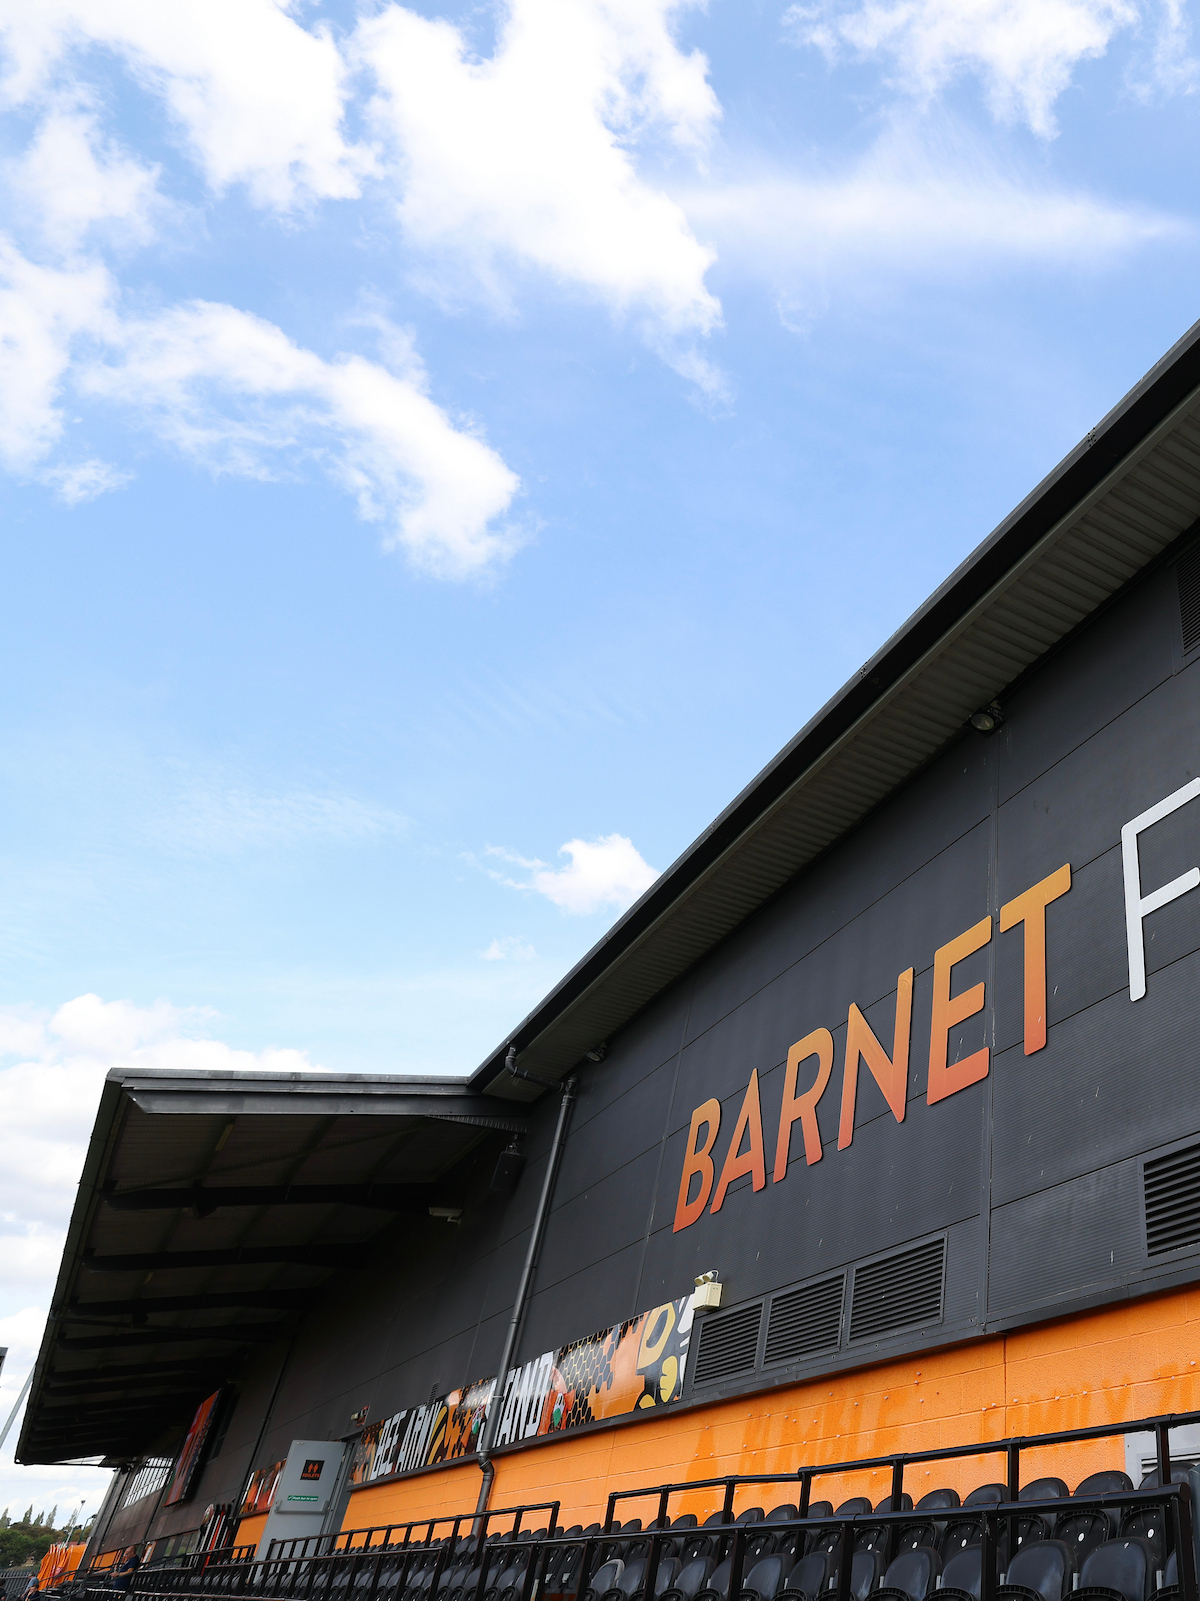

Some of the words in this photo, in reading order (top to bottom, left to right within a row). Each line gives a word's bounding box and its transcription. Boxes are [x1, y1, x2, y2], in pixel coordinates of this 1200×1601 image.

[672, 862, 1072, 1233] BARNET
[370, 1409, 408, 1481] BEE
[395, 1400, 443, 1473] ARMY
